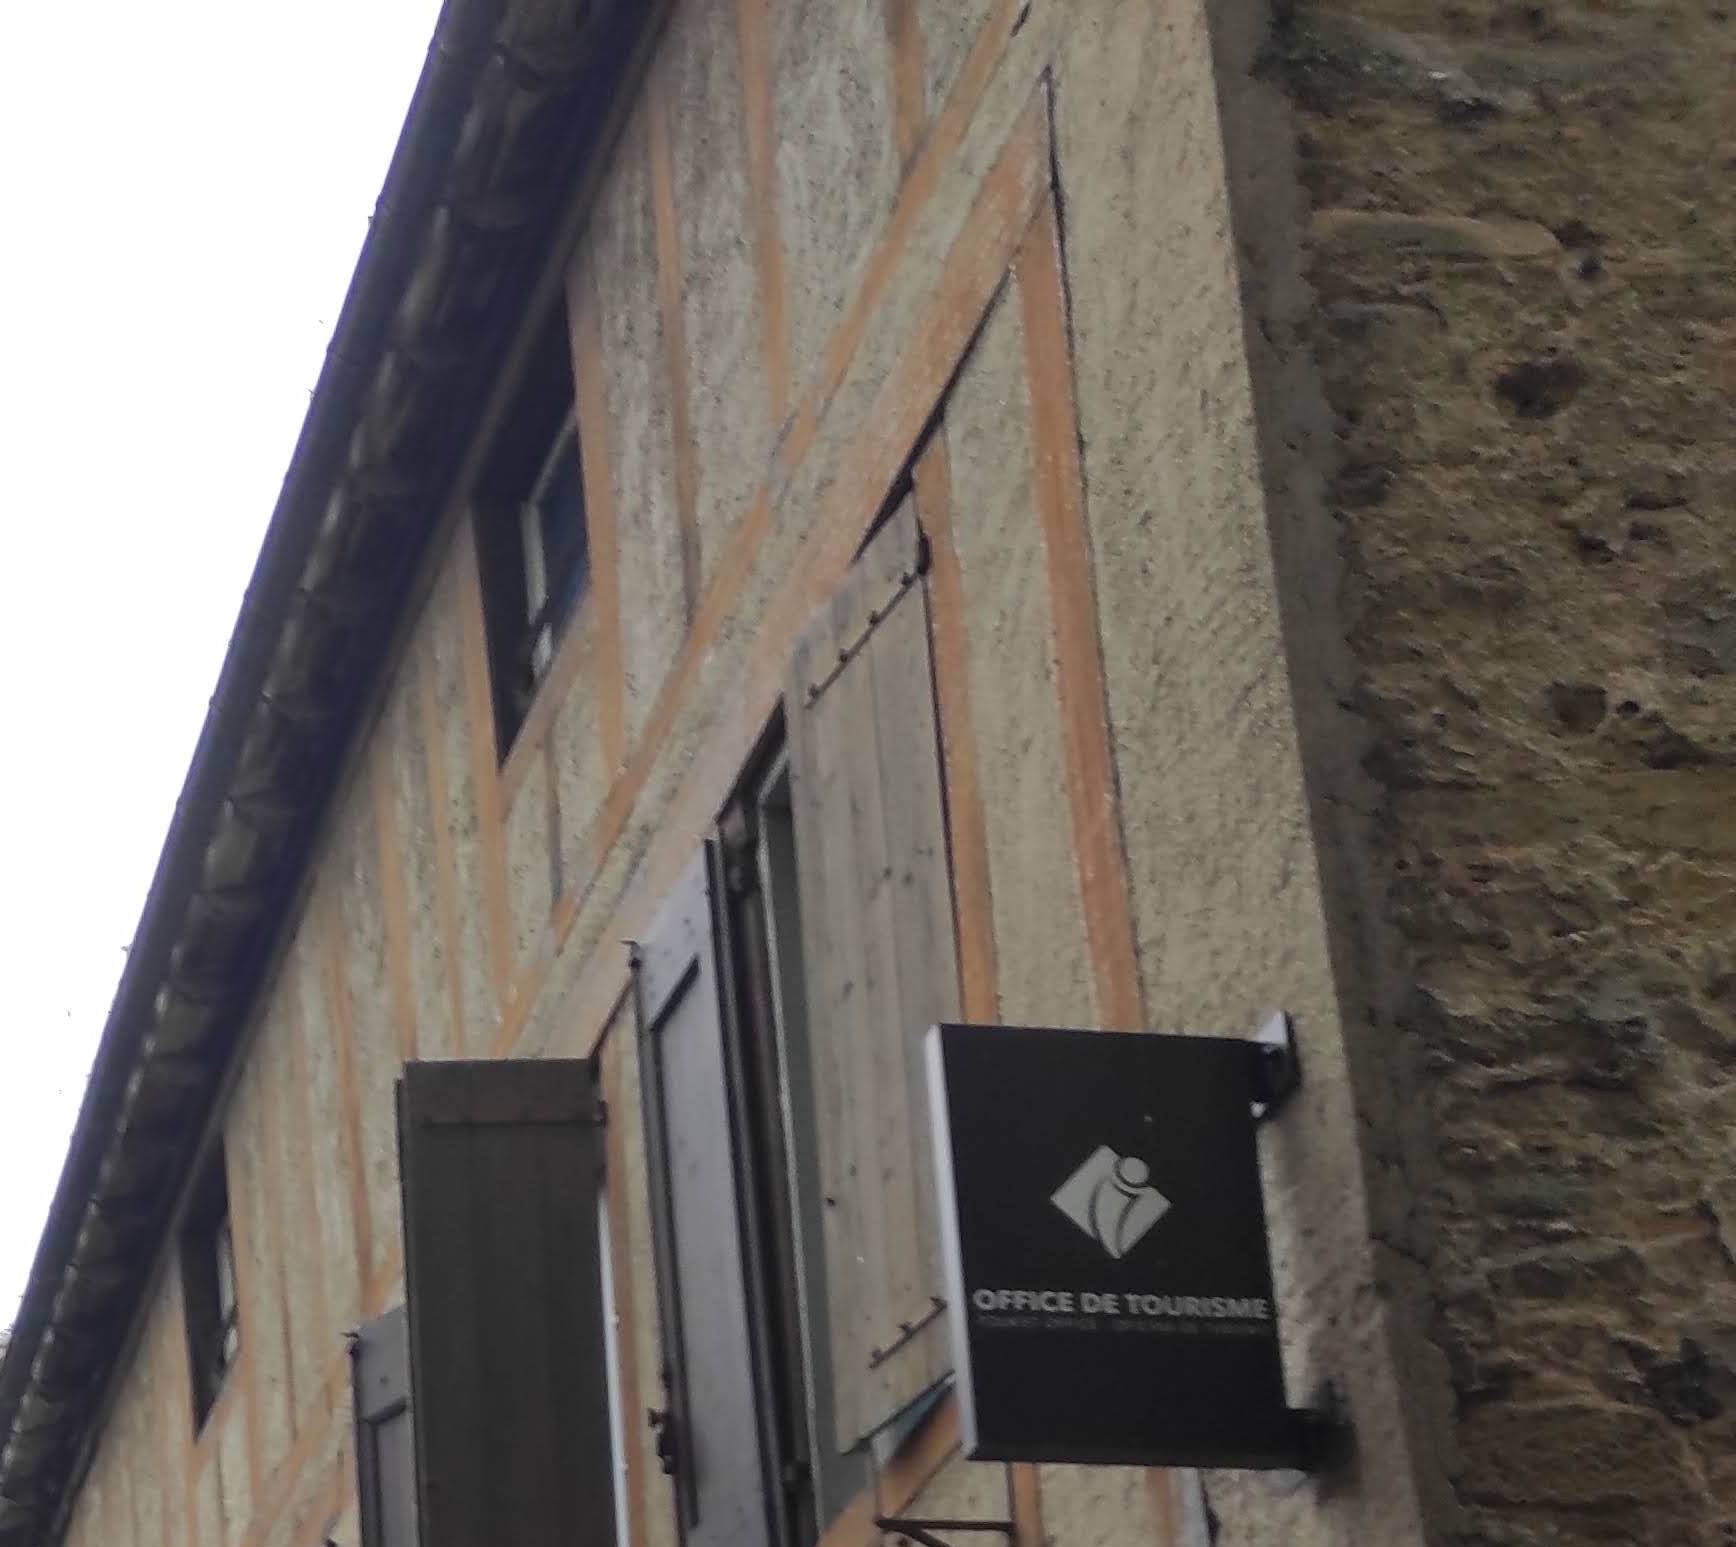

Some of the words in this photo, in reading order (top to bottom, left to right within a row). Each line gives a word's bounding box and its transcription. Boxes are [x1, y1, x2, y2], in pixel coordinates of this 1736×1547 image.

[972, 1288, 1074, 1312] OFFICE
[1080, 1292, 1120, 1314] DE
[1124, 1293, 1271, 1319] TOURISME
